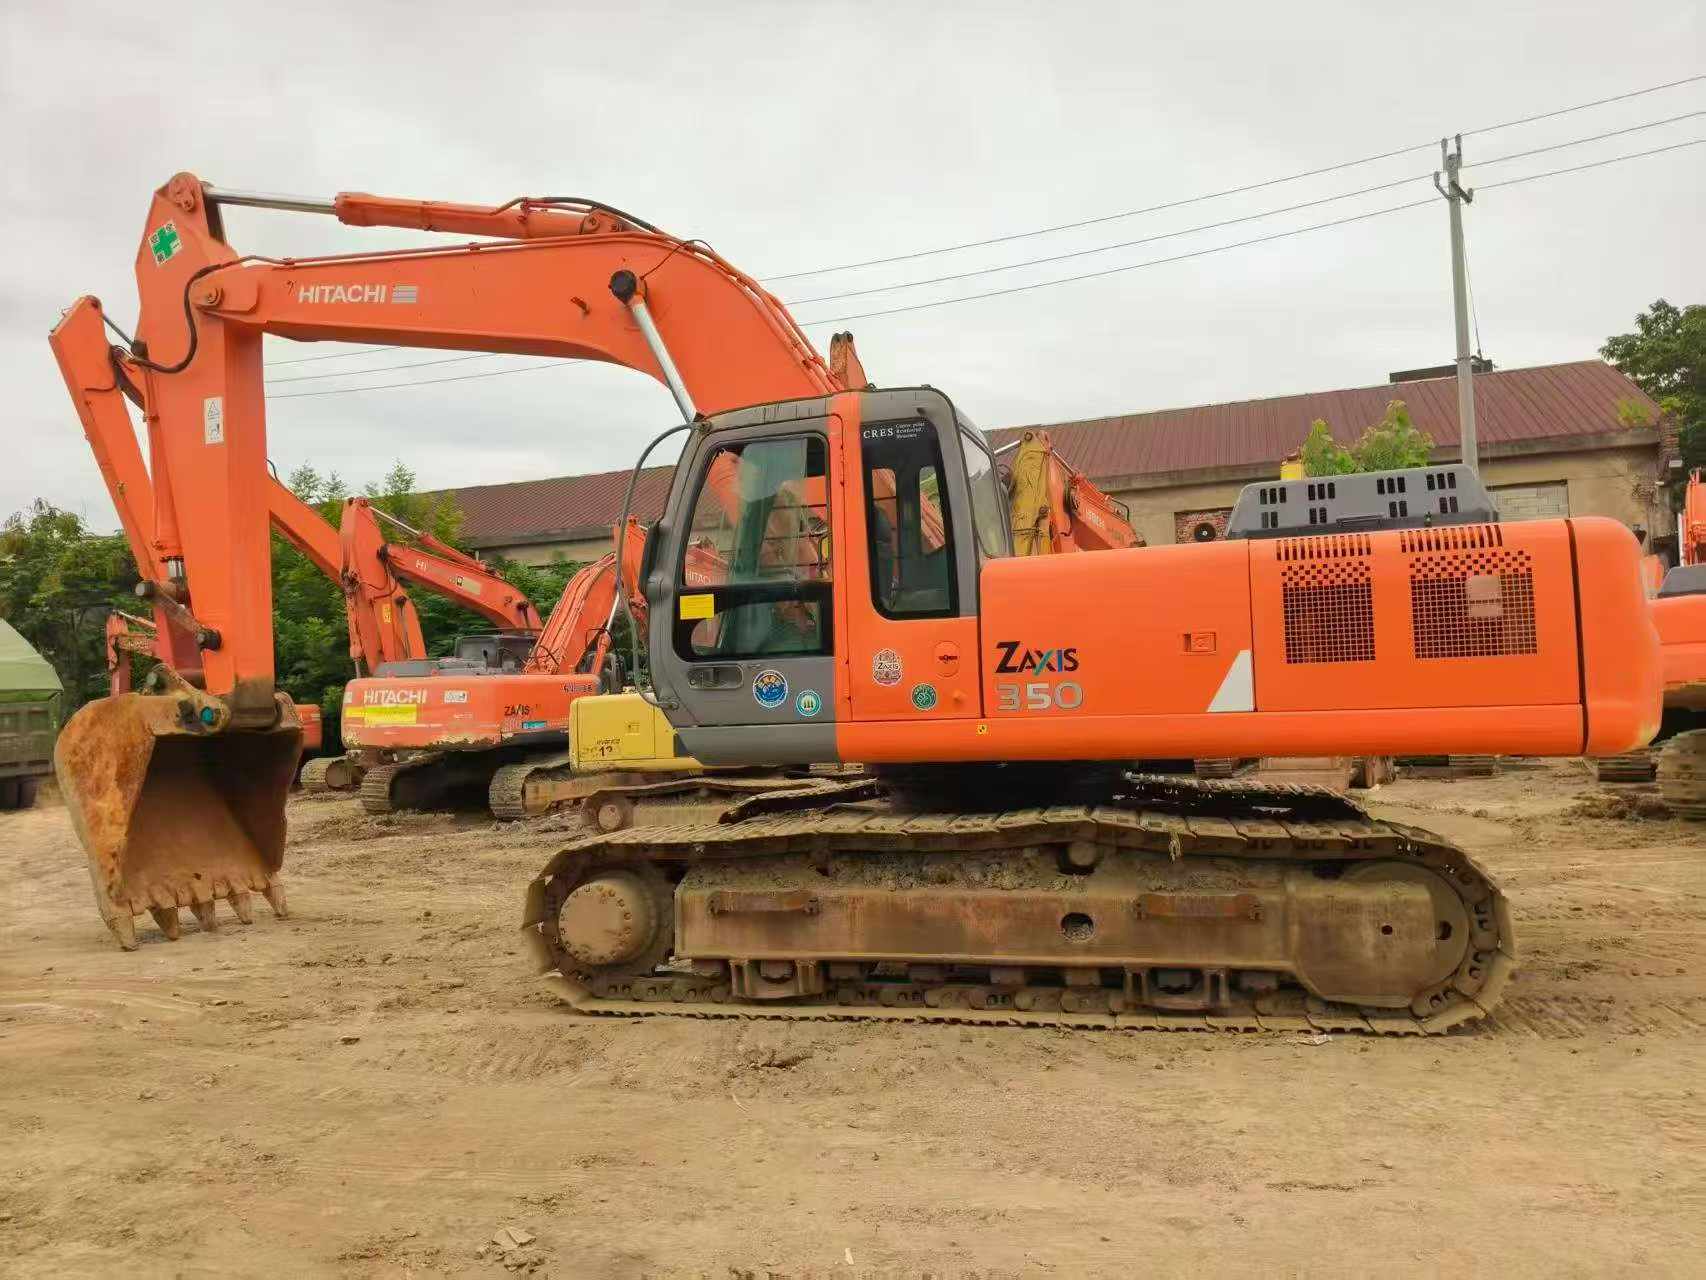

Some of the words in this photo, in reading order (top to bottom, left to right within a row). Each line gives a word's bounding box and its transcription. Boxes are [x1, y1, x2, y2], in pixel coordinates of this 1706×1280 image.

[298, 284, 387, 304] HITACHI
[863, 427, 894, 439] CRES
[994, 640, 1080, 677] ZAXIS
[363, 688, 428, 705] HITACHI
[997, 680, 1084, 711] 350
